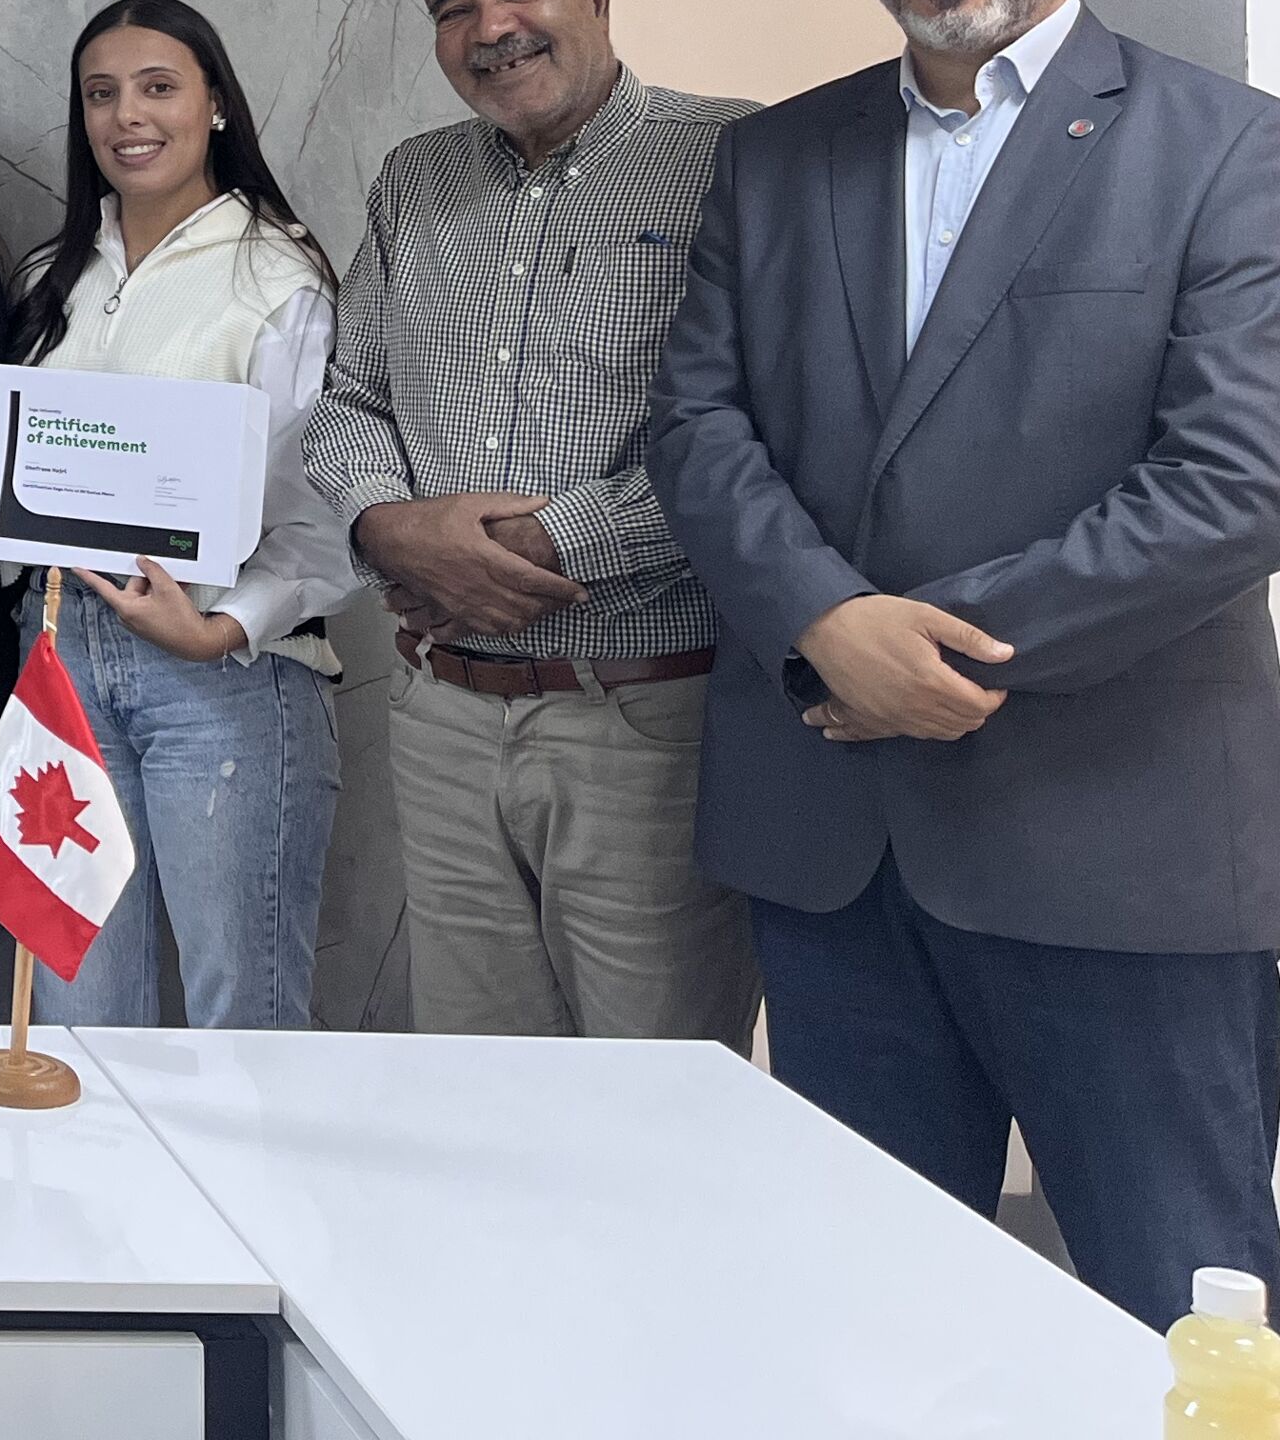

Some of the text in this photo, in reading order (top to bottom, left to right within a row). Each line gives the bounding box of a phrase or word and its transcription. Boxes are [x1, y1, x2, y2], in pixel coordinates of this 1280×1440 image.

[28, 415, 116, 435] Certificate
[27, 431, 147, 454] of achievement
[169, 535, 193, 551] Sage
